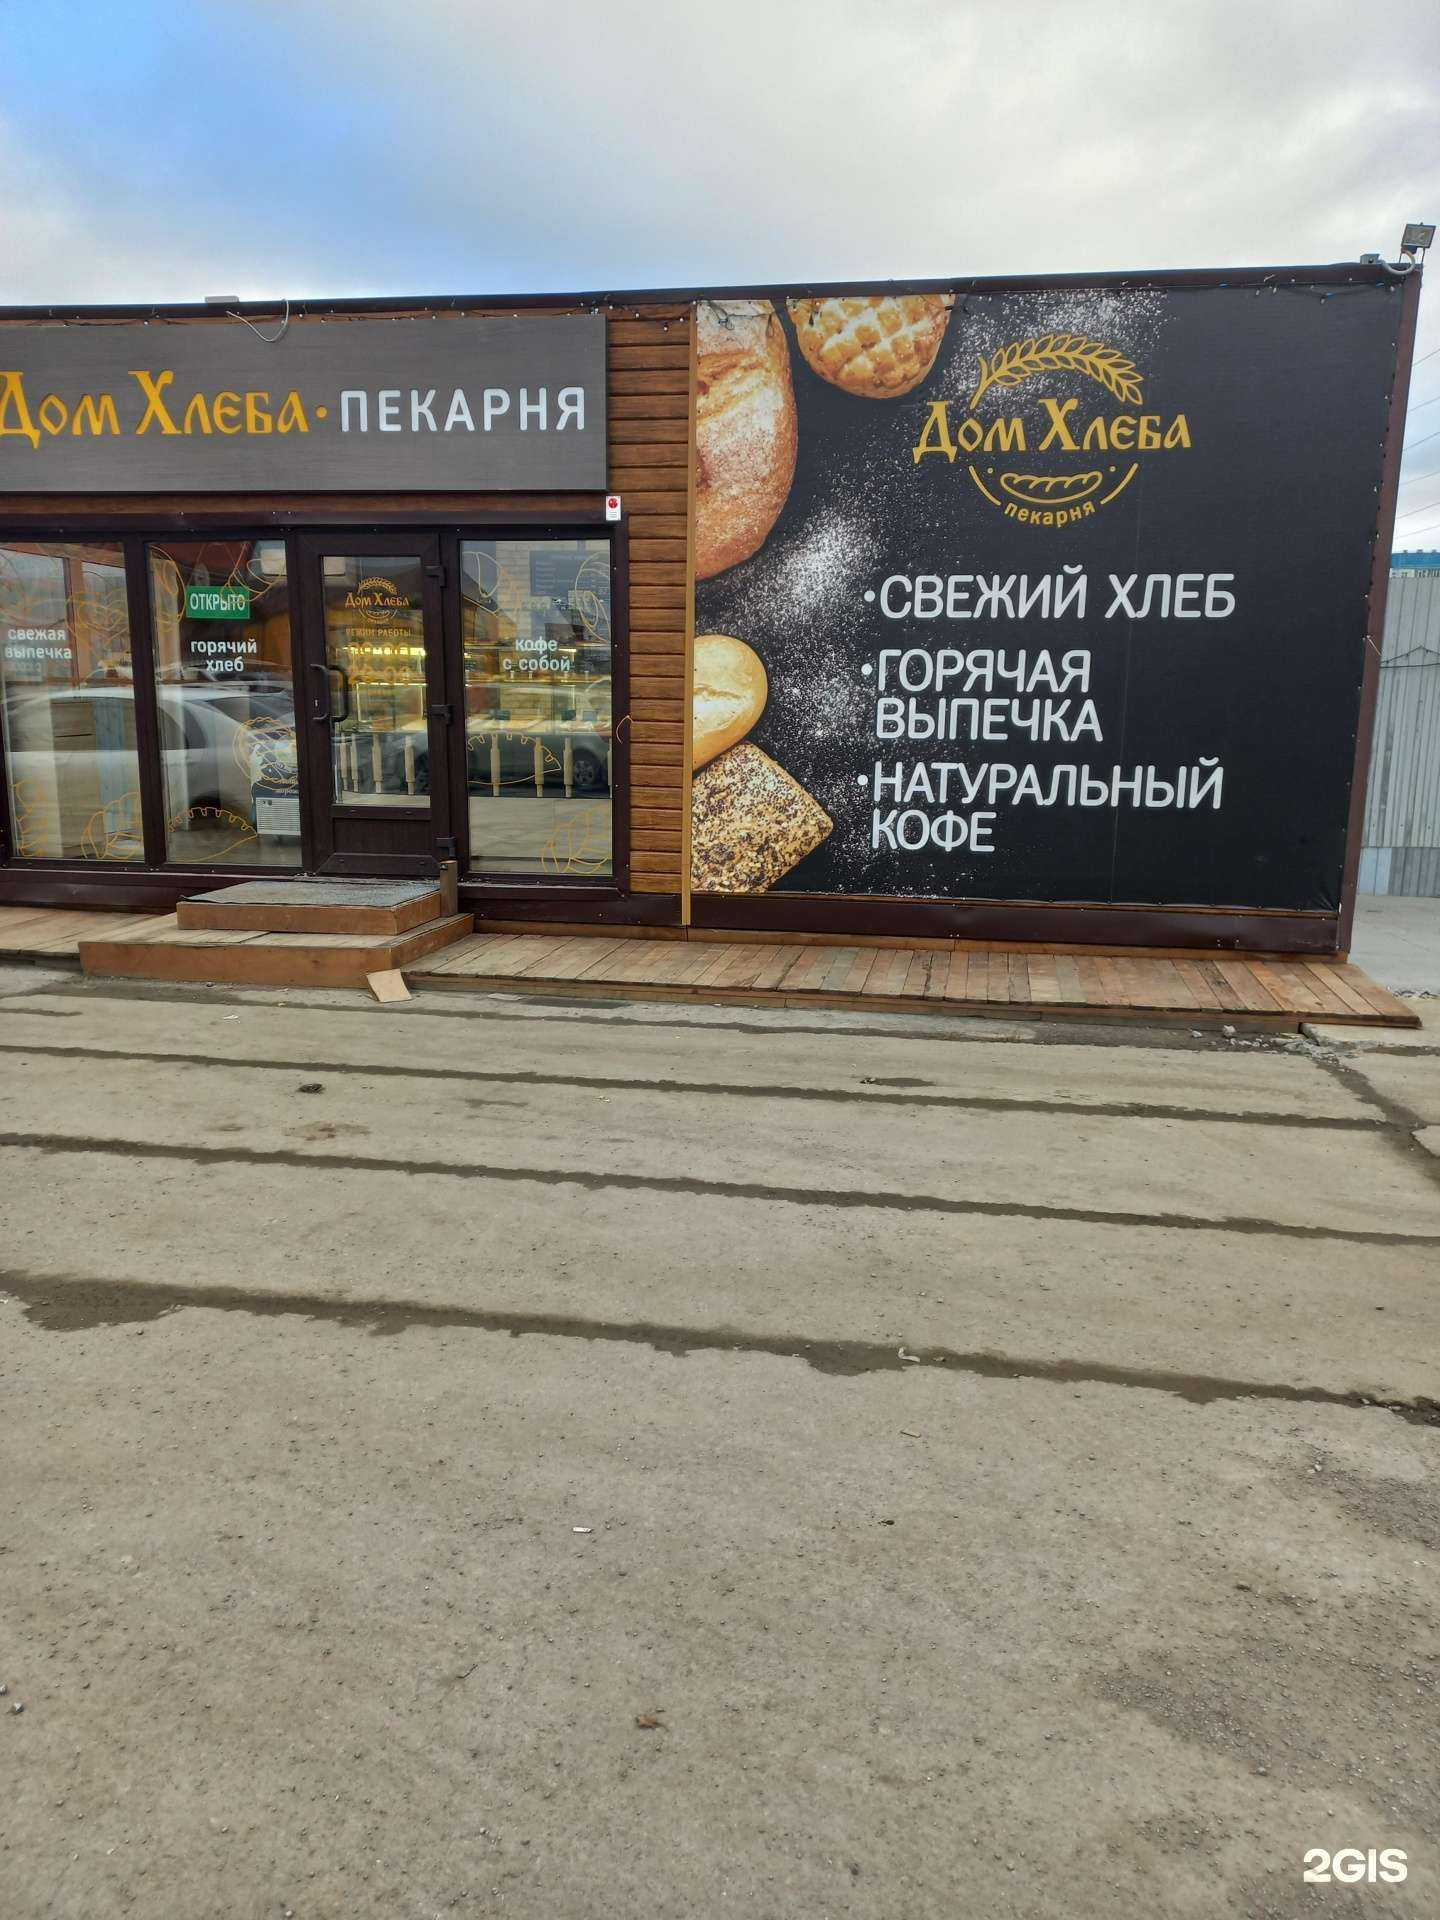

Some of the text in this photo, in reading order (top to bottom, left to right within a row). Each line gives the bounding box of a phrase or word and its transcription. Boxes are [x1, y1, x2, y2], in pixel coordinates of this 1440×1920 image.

[340, 386, 585, 432] ПЕКАРНЯ
[1003, 501, 1096, 528] пекарня
[189, 592, 246, 611] ОТКРЫТО
[880, 564, 1236, 618] СВЕЖИЙ ХЛЕБ
[7, 628, 66, 640] свежая
[515, 636, 558, 654] кофе
[4, 646, 73, 660] выпечка
[190, 638, 257, 656] горячий
[206, 656, 244, 672] хлеб
[502, 656, 571, 671] с собой
[877, 649, 1091, 693] ГОРЯЧАЯ
[876, 697, 1103, 742] ВЫПЕЧКА
[873, 756, 1225, 810] НАТУРАЛЬНЫЙ
[872, 808, 997, 852] КОФЕ
